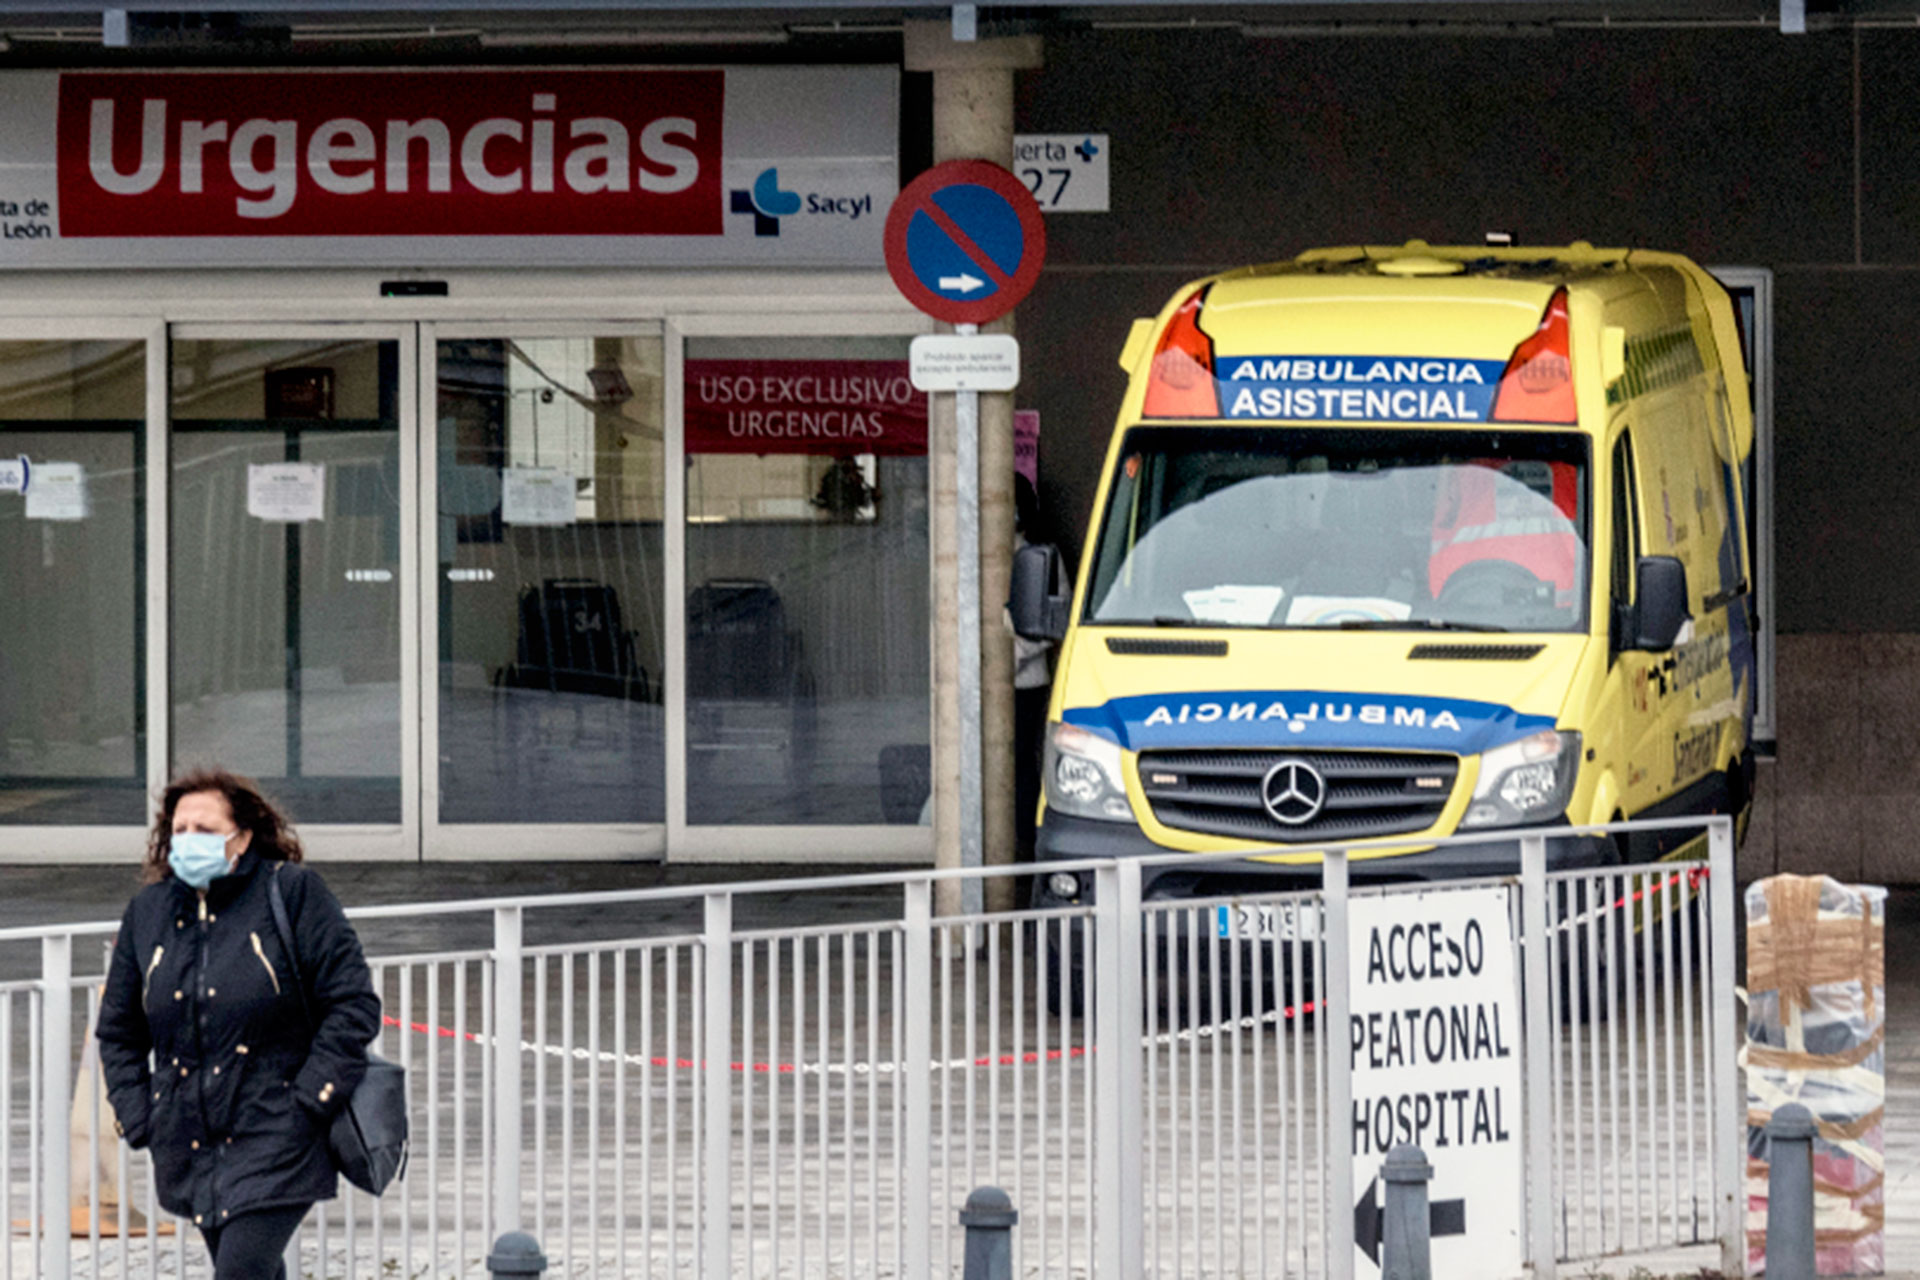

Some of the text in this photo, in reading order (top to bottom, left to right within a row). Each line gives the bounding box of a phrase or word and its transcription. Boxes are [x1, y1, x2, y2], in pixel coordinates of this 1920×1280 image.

[88, 93, 700, 218] Urgencias
[1022, 168, 1071, 206] 27
[24, 198, 50, 216] de
[806, 193, 871, 219] Sacyl
[3, 219, 52, 239] León
[1231, 360, 1484, 384] AMBULANCIA
[700, 376, 913, 404] USO EXCLUSIVO
[1231, 388, 1479, 419] ASISTENCIAL
[728, 410, 884, 437] URGENCIAS
[1367, 918, 1484, 985] ACCESO
[1350, 1002, 1511, 1071] PEATONAL
[1352, 1086, 1510, 1156] HOSPITAL
